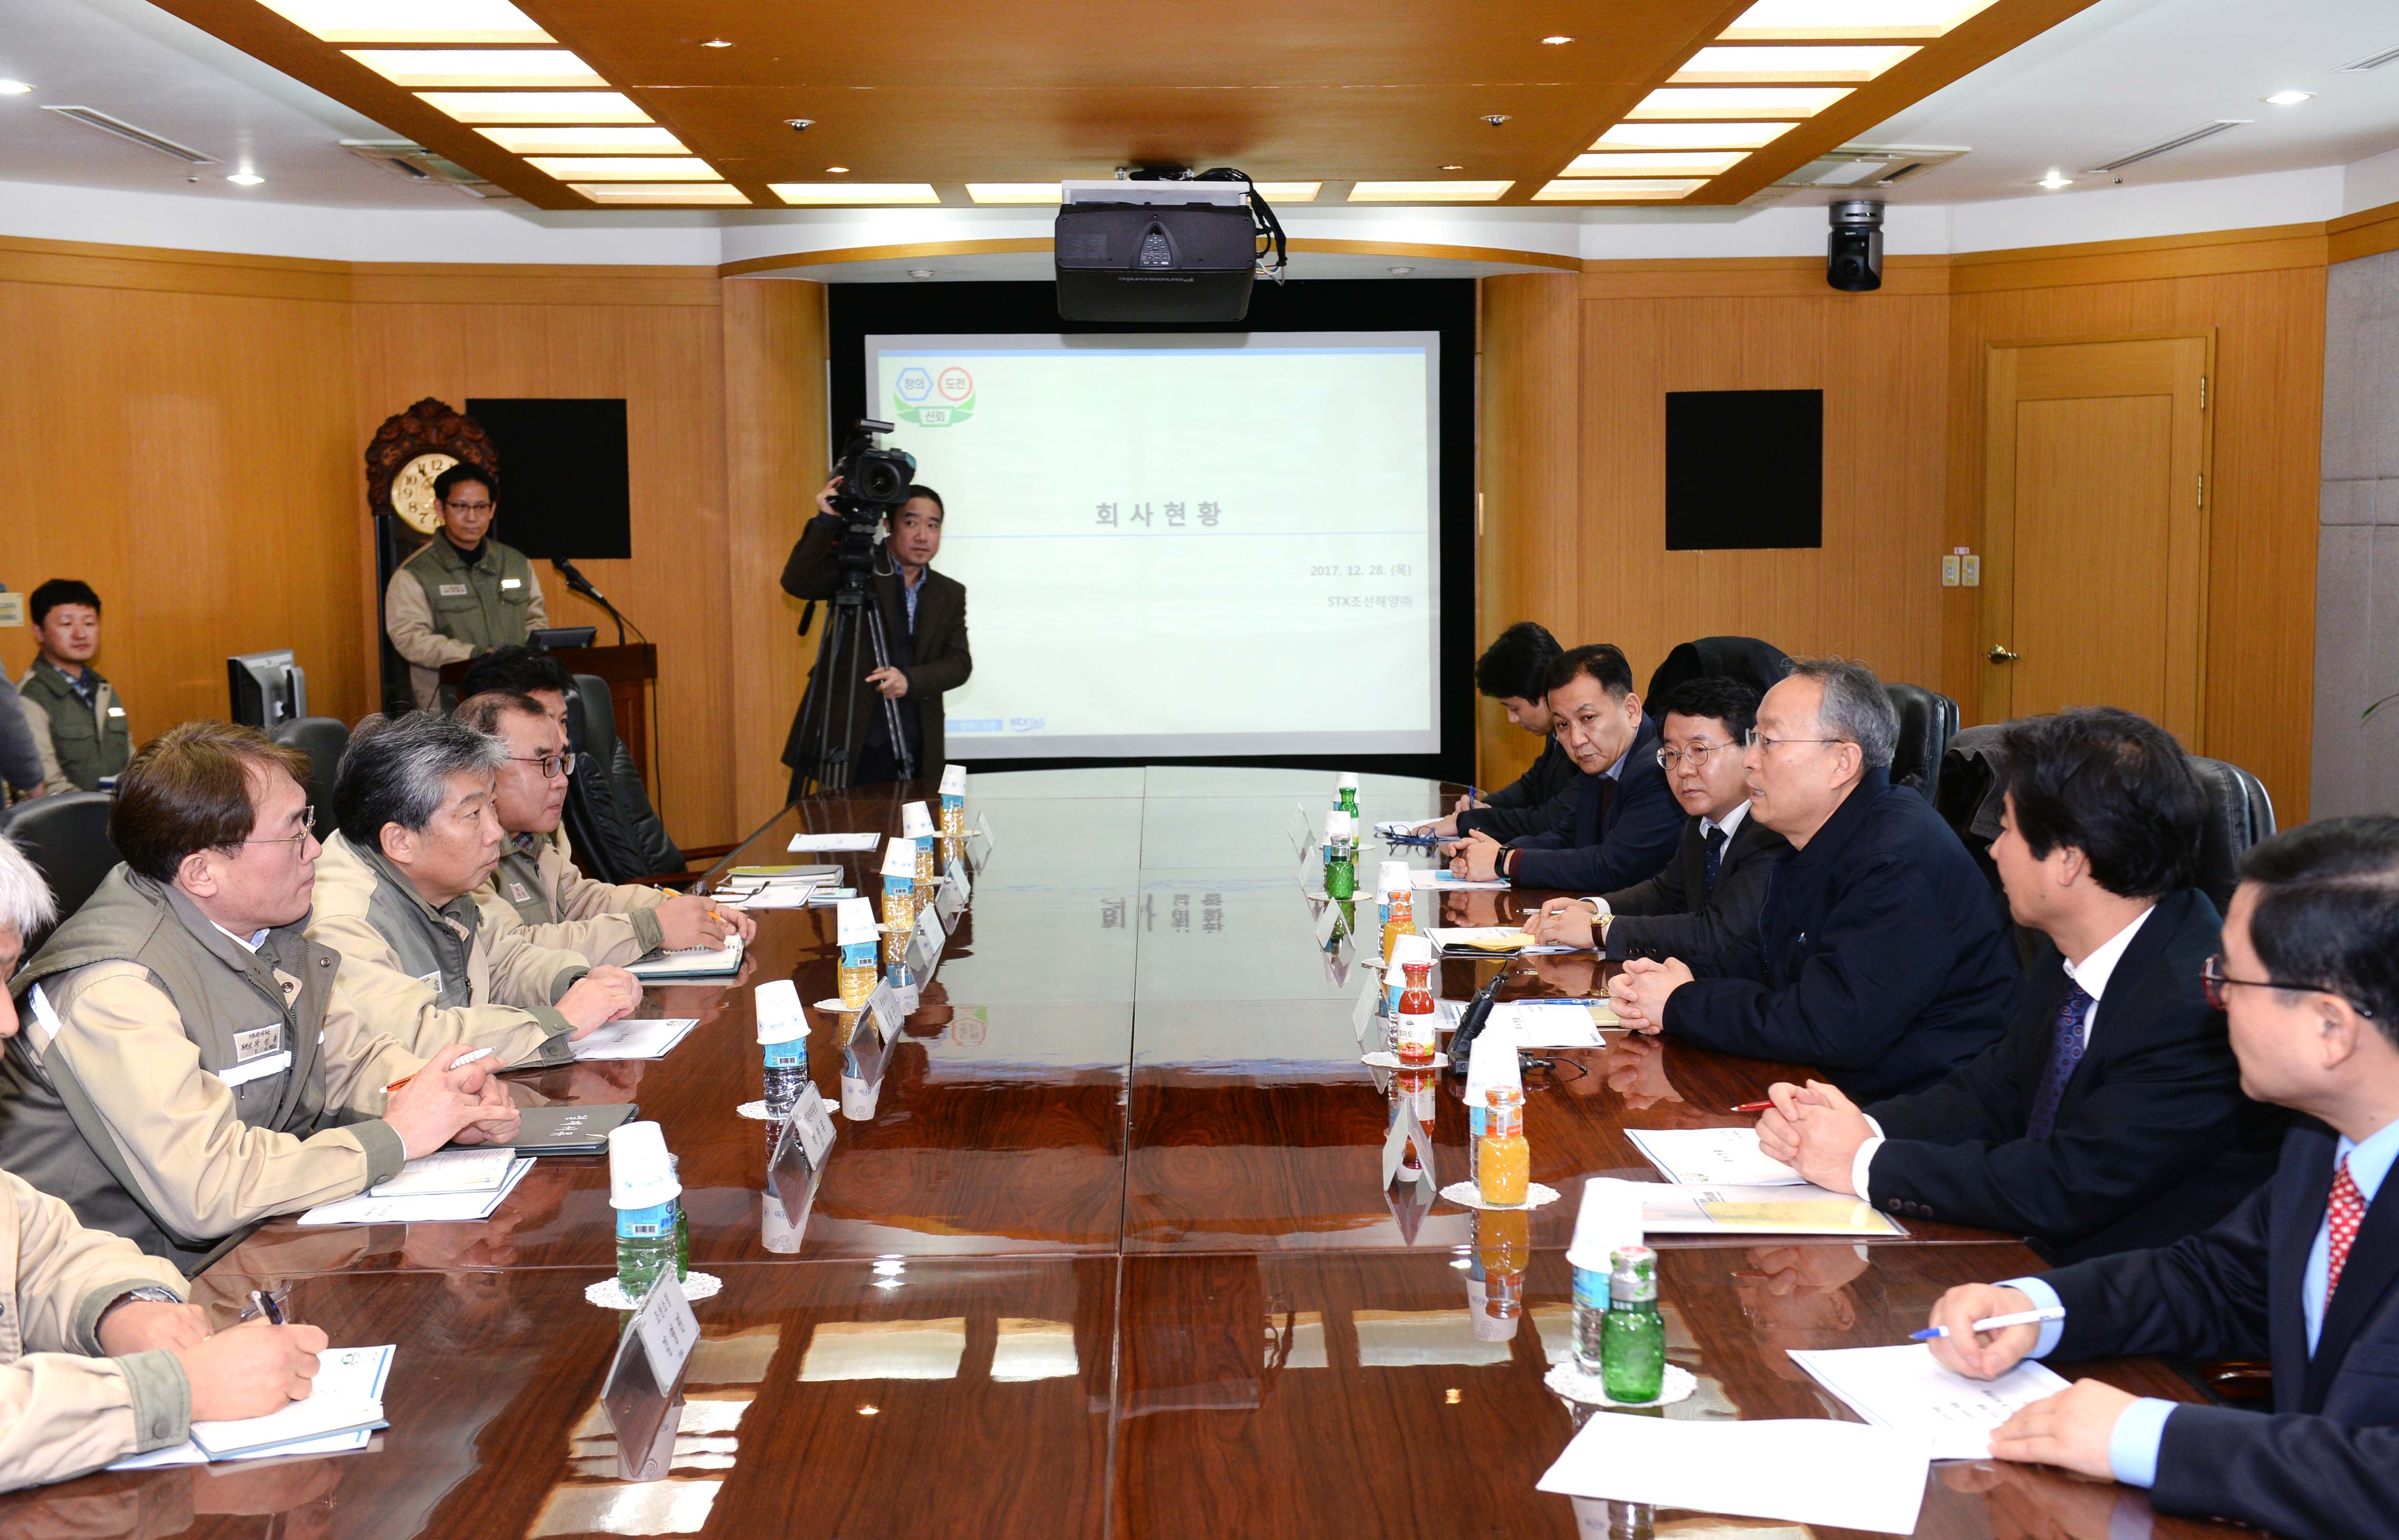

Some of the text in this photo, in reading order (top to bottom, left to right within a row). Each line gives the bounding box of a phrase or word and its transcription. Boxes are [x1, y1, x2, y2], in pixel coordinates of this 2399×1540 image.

[904, 378, 925, 390] 창의
[945, 378, 966, 389] 도전
[925, 411, 945, 422] 신뢰
[431, 459, 442, 470] 12
[404, 488, 412, 499] 9
[408, 501, 417, 513] 8
[419, 512, 429, 524] 7
[1095, 501, 1222, 528] 회사현황
[1310, 564, 1412, 577] 2017. 12. 28. (목)
